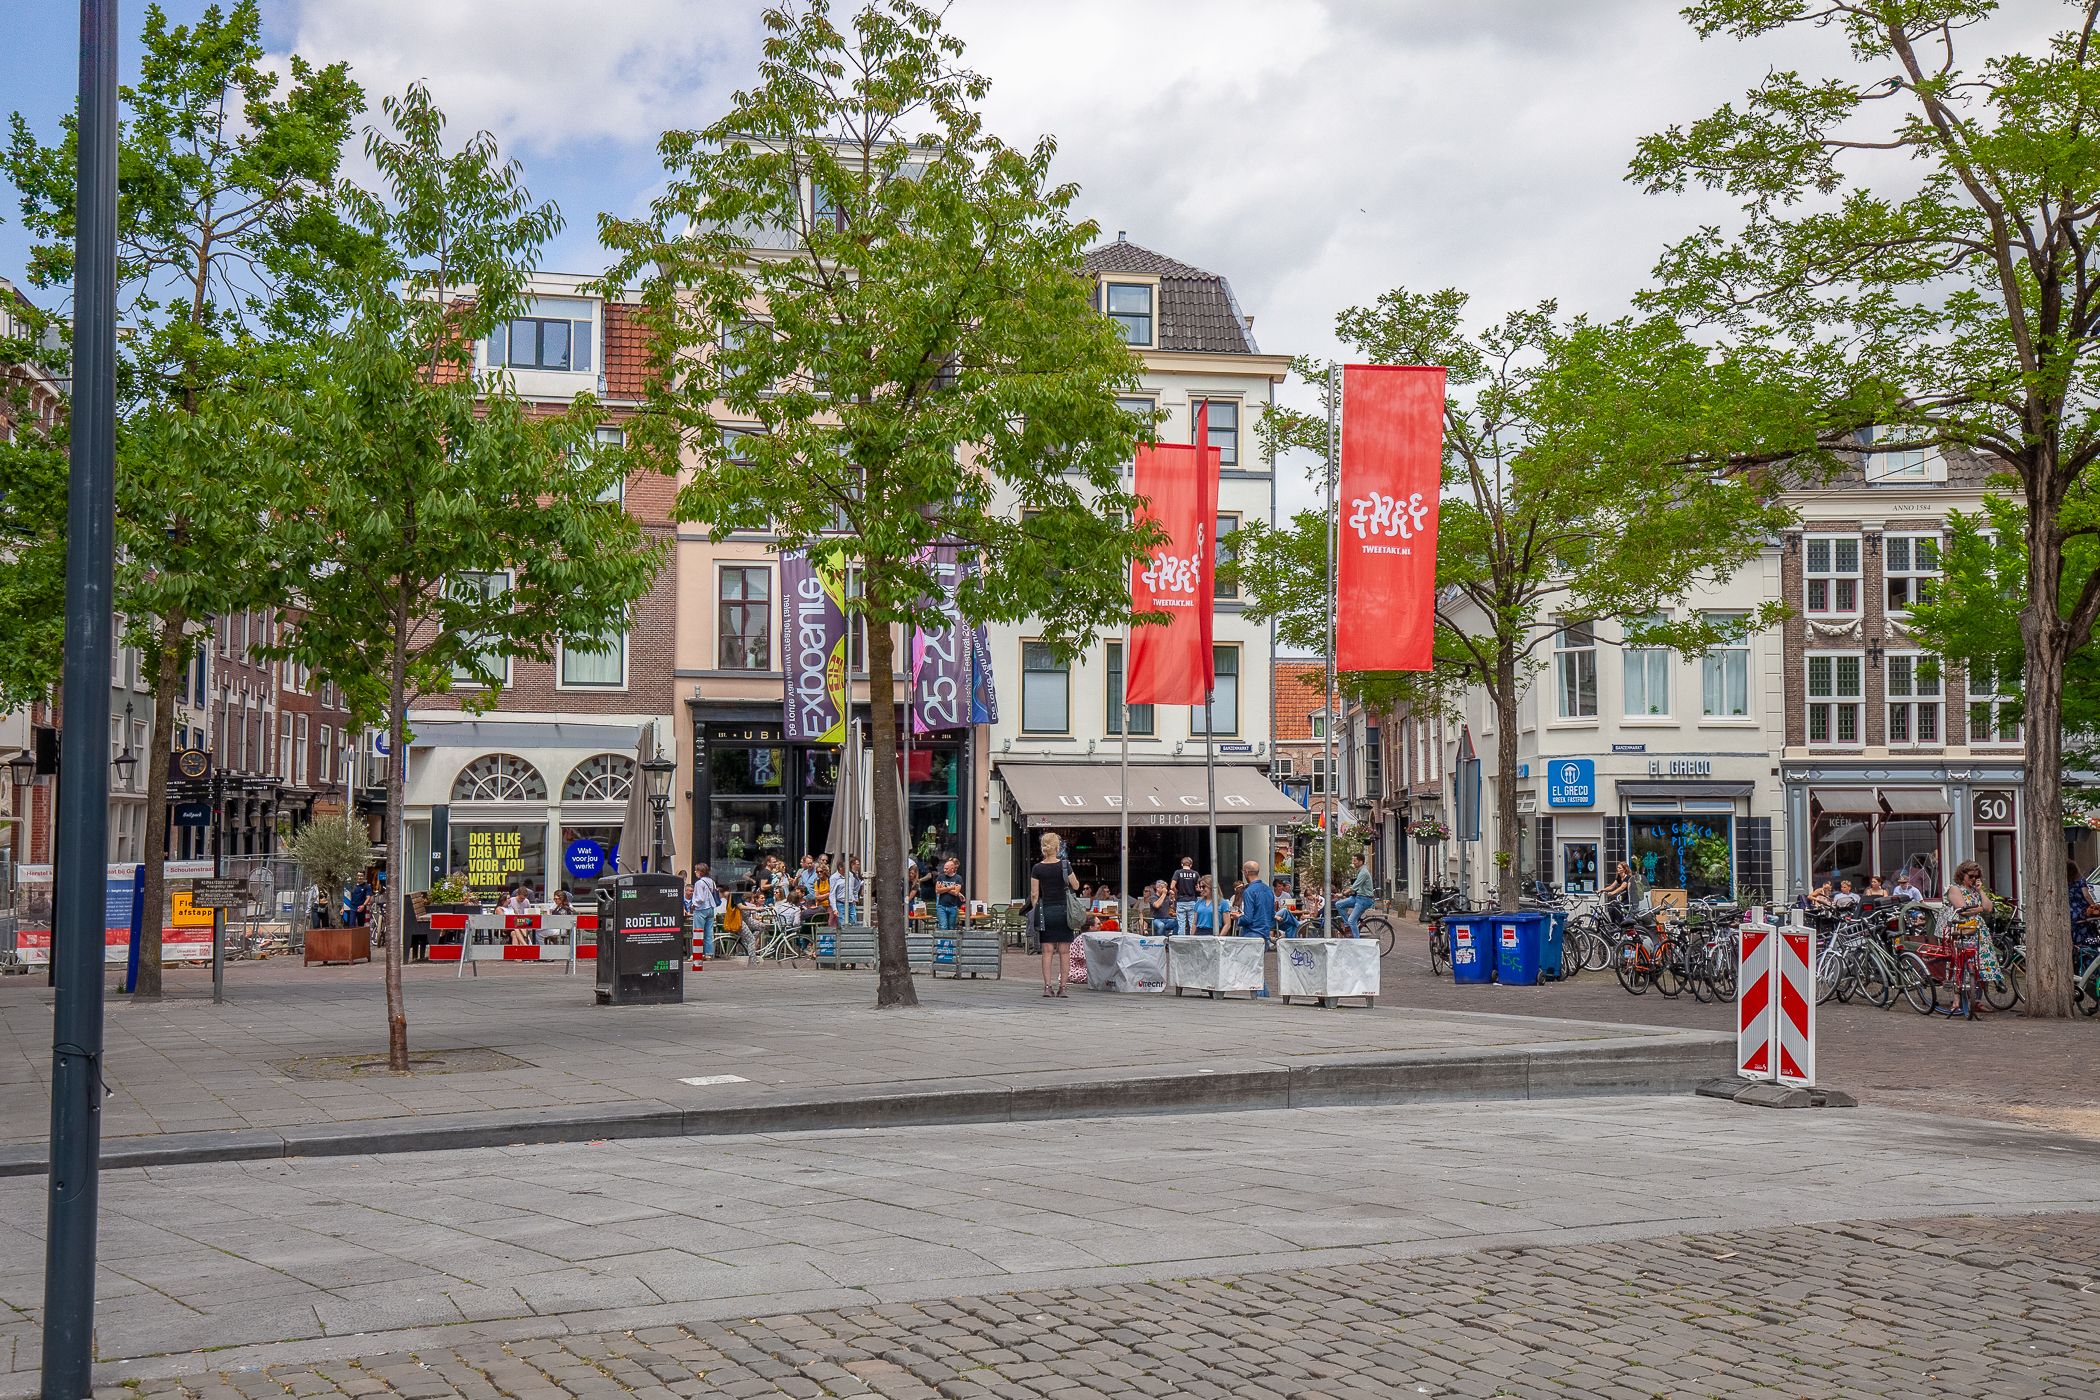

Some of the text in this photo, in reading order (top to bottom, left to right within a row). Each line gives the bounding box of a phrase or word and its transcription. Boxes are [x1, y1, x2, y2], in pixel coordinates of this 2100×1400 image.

[1362, 545, 1411, 555] TWEETAKT.NL
[1152, 598, 1194, 607] TWEETAKT.NL
[1649, 760, 1712, 775] EL GRECO
[1552, 785, 1589, 796] EL GRECO
[1059, 795, 1255, 807] UBICA
[1979, 799, 2007, 820] 30
[1150, 814, 1190, 825] UBICA
[469, 832, 521, 845] DOE ELKE
[1671, 836, 1695, 847] PITA
[469, 846, 520, 858] DAG WAT
[469, 859, 525, 871] VOOR JOU
[587, 855, 598, 863] jou
[26, 869, 48, 877] Herstel
[469, 873, 508, 885] WERKT
[625, 916, 676, 928] RODE LIJN
